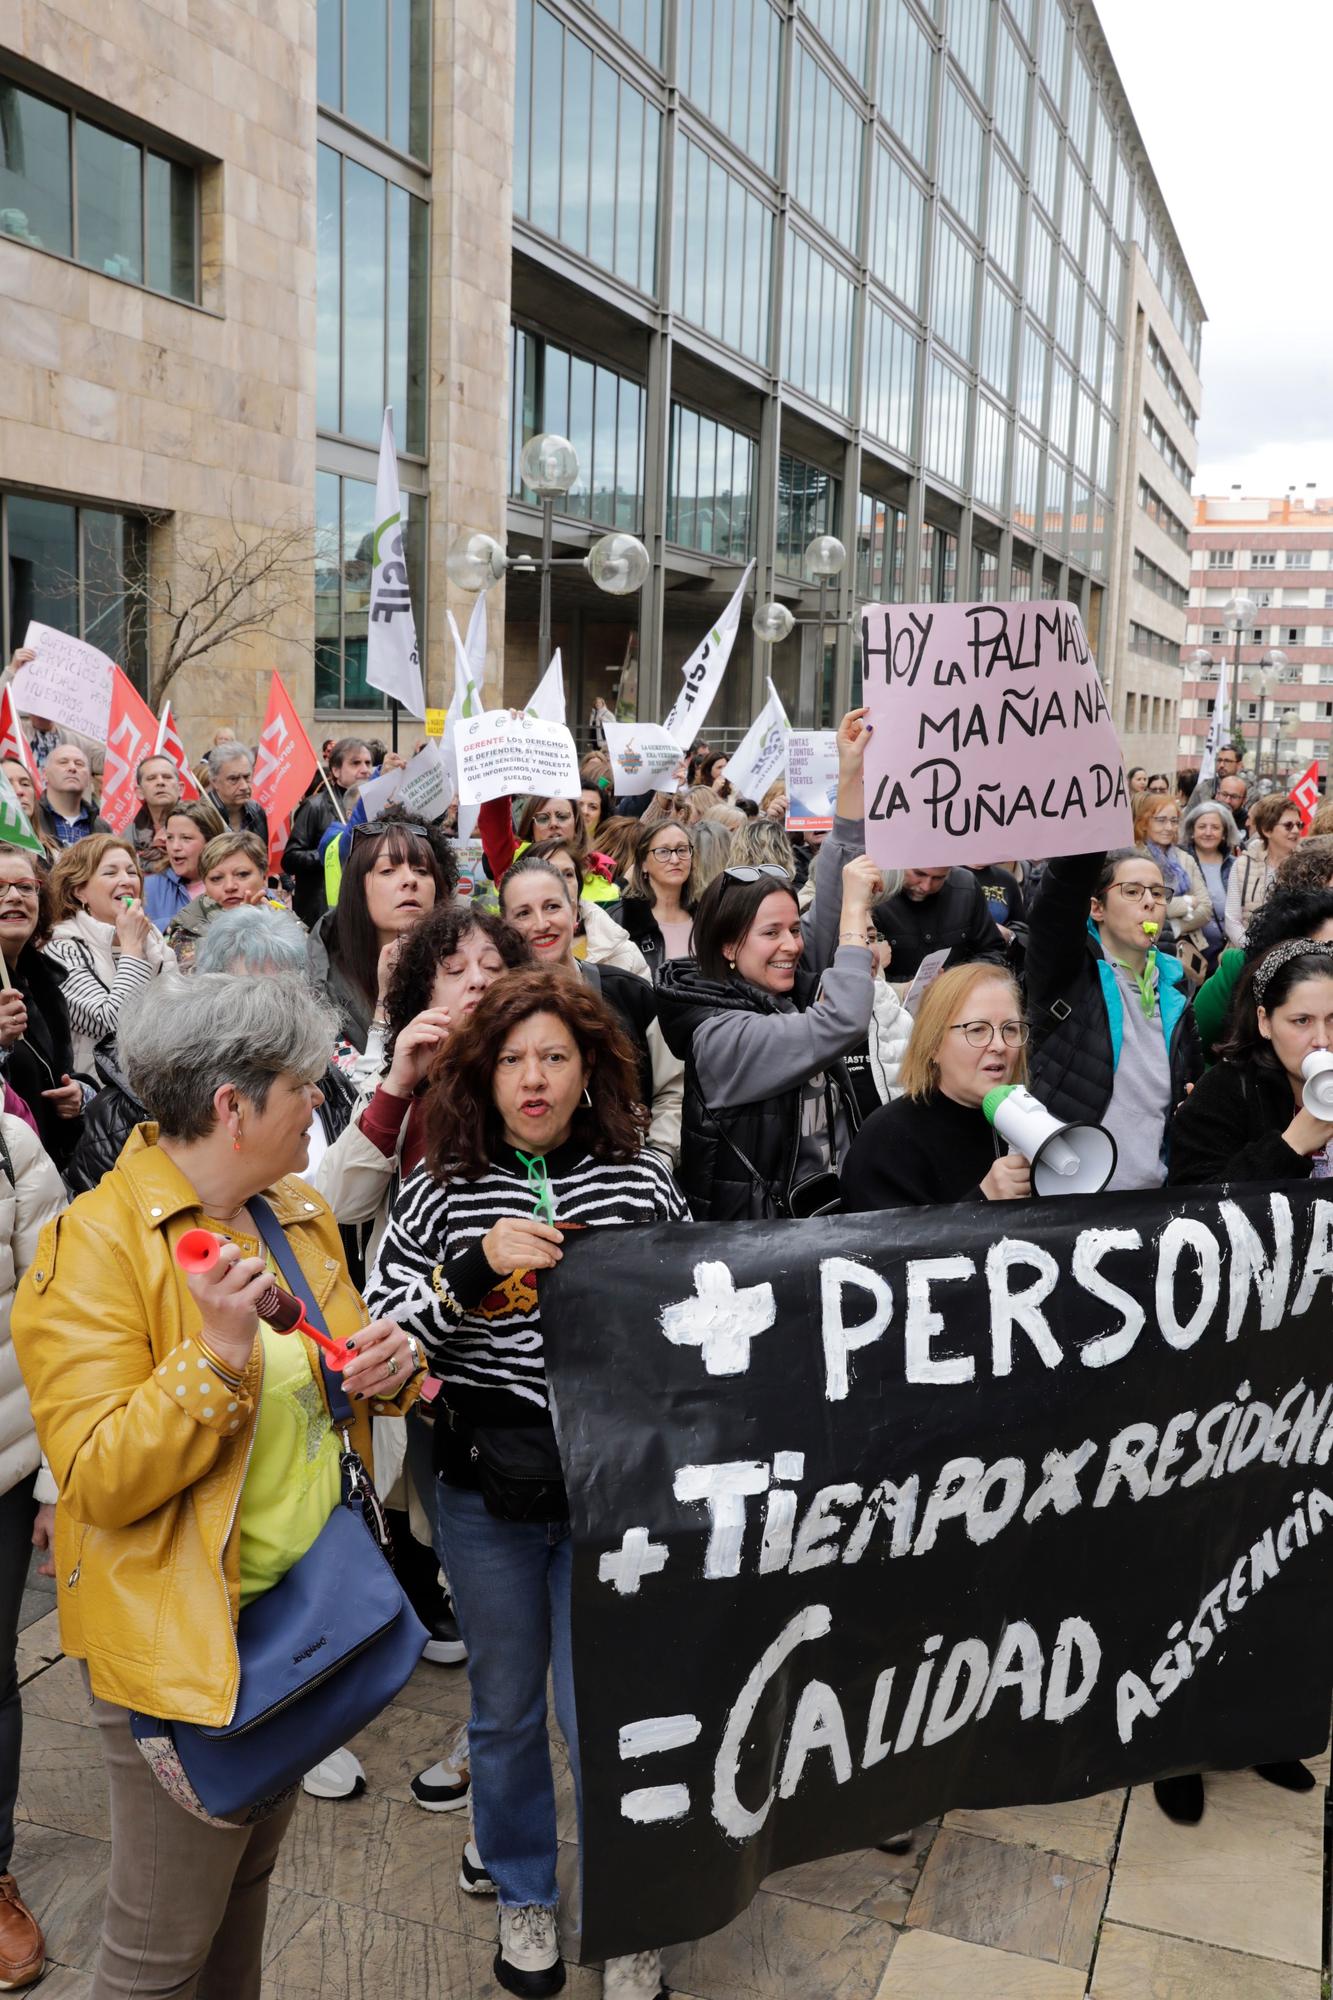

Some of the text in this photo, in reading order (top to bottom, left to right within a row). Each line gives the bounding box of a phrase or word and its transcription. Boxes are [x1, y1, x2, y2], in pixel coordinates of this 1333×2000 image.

[862, 605, 1090, 687] HOY LA PALMAD
[918, 679, 1111, 752] MAÑANA
[463, 736, 505, 752] GERENTE
[525, 738, 569, 749] DERECHOS
[788, 738, 809, 747] JUNTAS
[534, 749, 559, 759] TIENES
[789, 748, 793, 756] Y
[793, 747, 815, 756] JUNTOS
[463, 765, 479, 773] PIEL
[480, 761, 494, 769] TAN
[495, 757, 532, 765] SENSIBLE
[538, 759, 572, 769] MOLESTA
[788, 757, 808, 766] SOMOS
[467, 774, 481, 782] QUE
[542, 769, 557, 777] CON
[789, 776, 814, 786] FUERTES
[869, 757, 1128, 836] LA PUÑALADA
